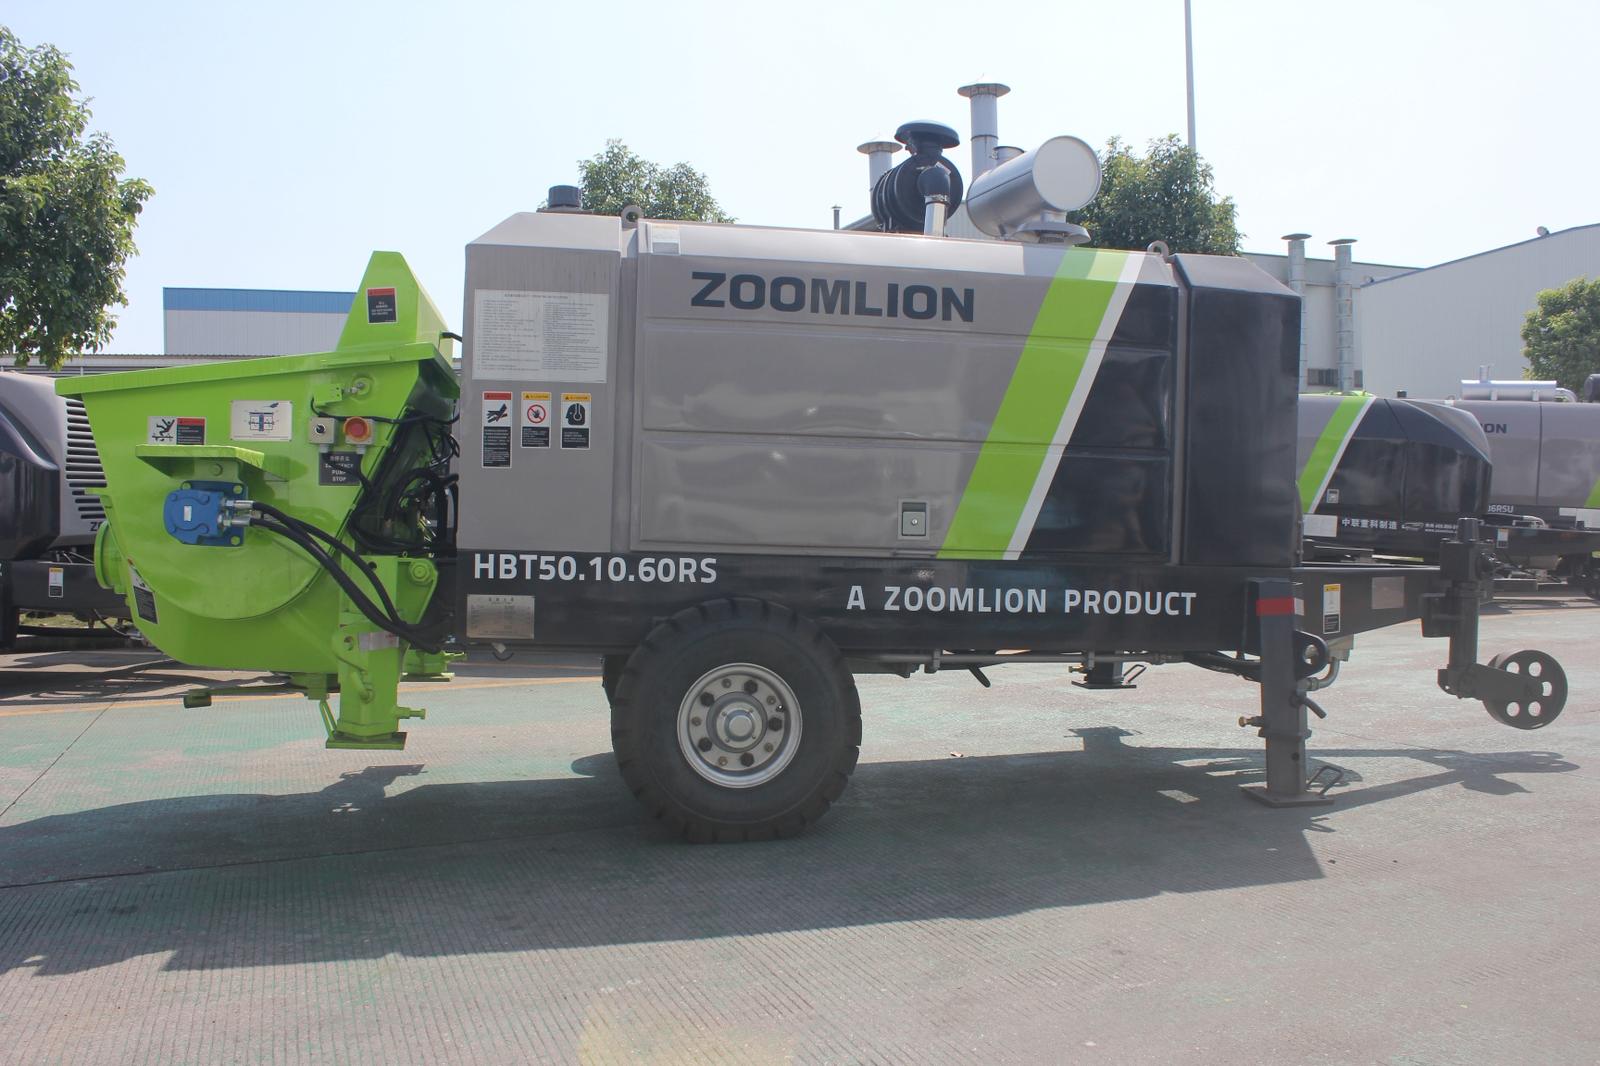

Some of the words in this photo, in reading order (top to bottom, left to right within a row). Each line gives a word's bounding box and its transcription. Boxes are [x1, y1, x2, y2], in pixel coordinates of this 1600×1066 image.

[691, 271, 975, 322] ZOOMLION
[1341, 518, 1398, 530] 中联重科制造
[474, 553, 717, 583] HBT50.10.60RS
[846, 585, 866, 610] A
[884, 586, 1047, 613] ZOOMLION
[1064, 589, 1197, 616] PRODUCT
